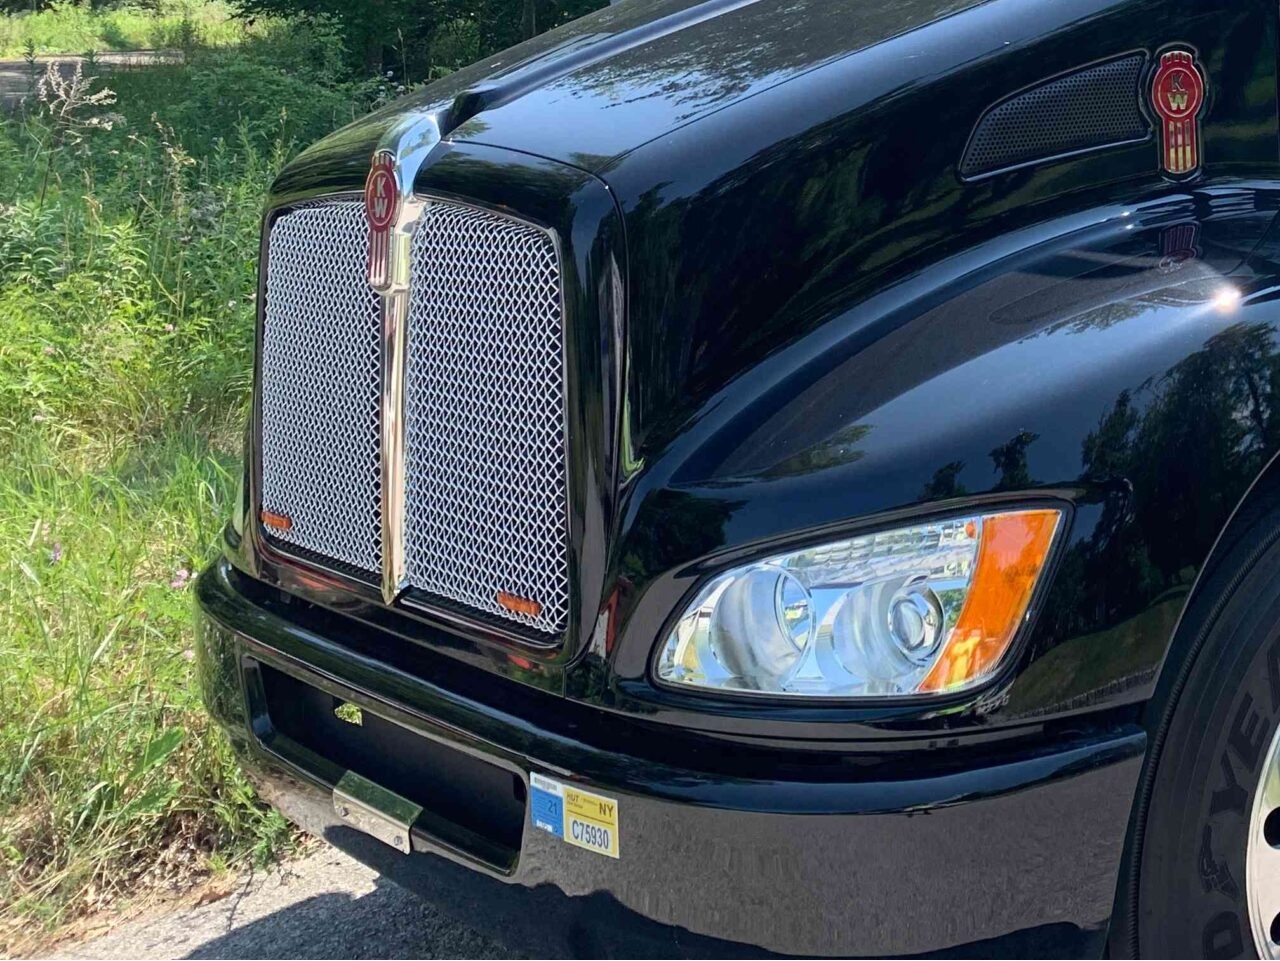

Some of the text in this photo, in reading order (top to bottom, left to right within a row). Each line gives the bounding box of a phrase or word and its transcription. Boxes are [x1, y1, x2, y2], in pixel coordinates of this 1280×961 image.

[547, 800, 558, 816] 21
[598, 802, 614, 818] NY
[571, 819, 609, 850] C75930
